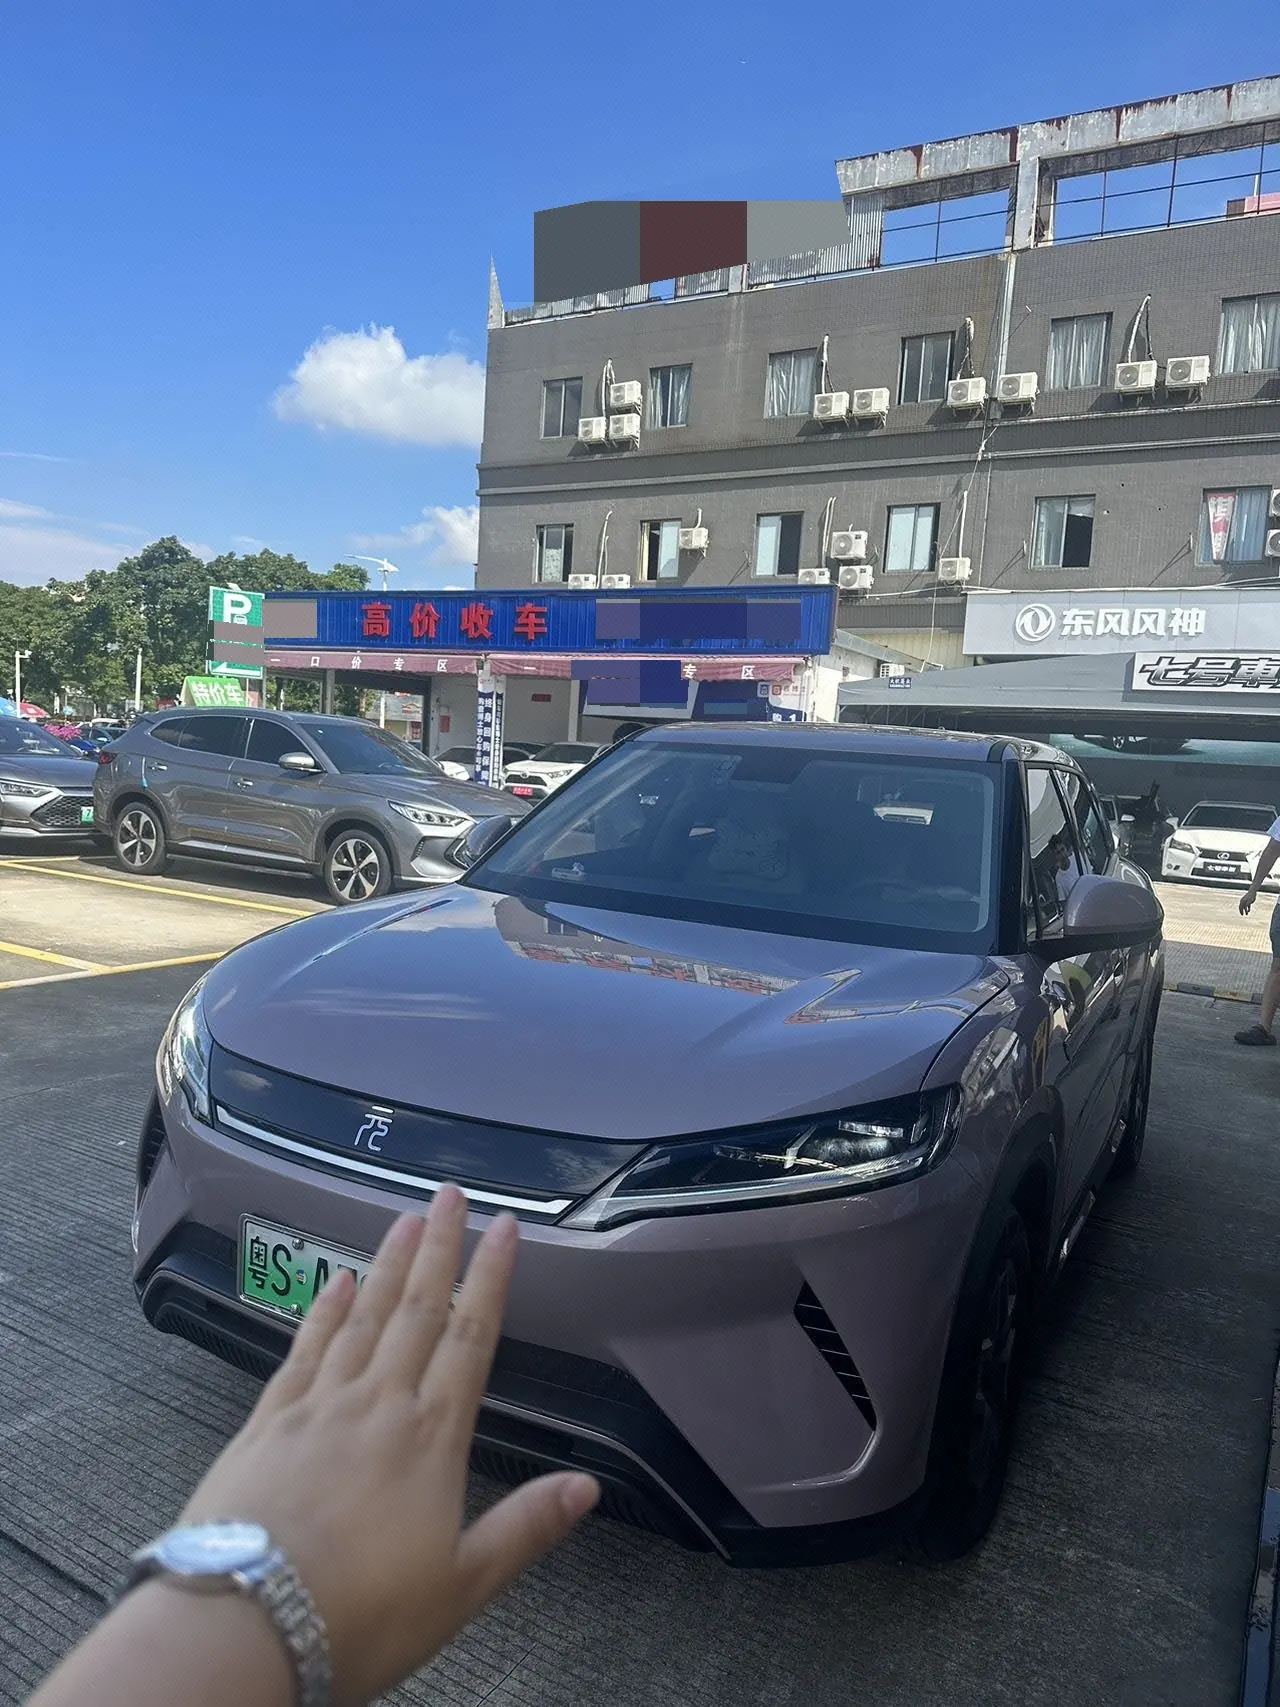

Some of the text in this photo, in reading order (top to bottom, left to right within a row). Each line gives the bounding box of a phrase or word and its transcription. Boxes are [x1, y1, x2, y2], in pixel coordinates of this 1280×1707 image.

[223, 592, 253, 624] P
[362, 602, 547, 640] 高价收车
[1062, 607, 1207, 639] 东风风神
[270, 655, 448, 672] 一口价专区
[1139, 656, 1280, 688] 七号車
[190, 680, 246, 707] 特价车
[353, 1104, 394, 1152] 元
